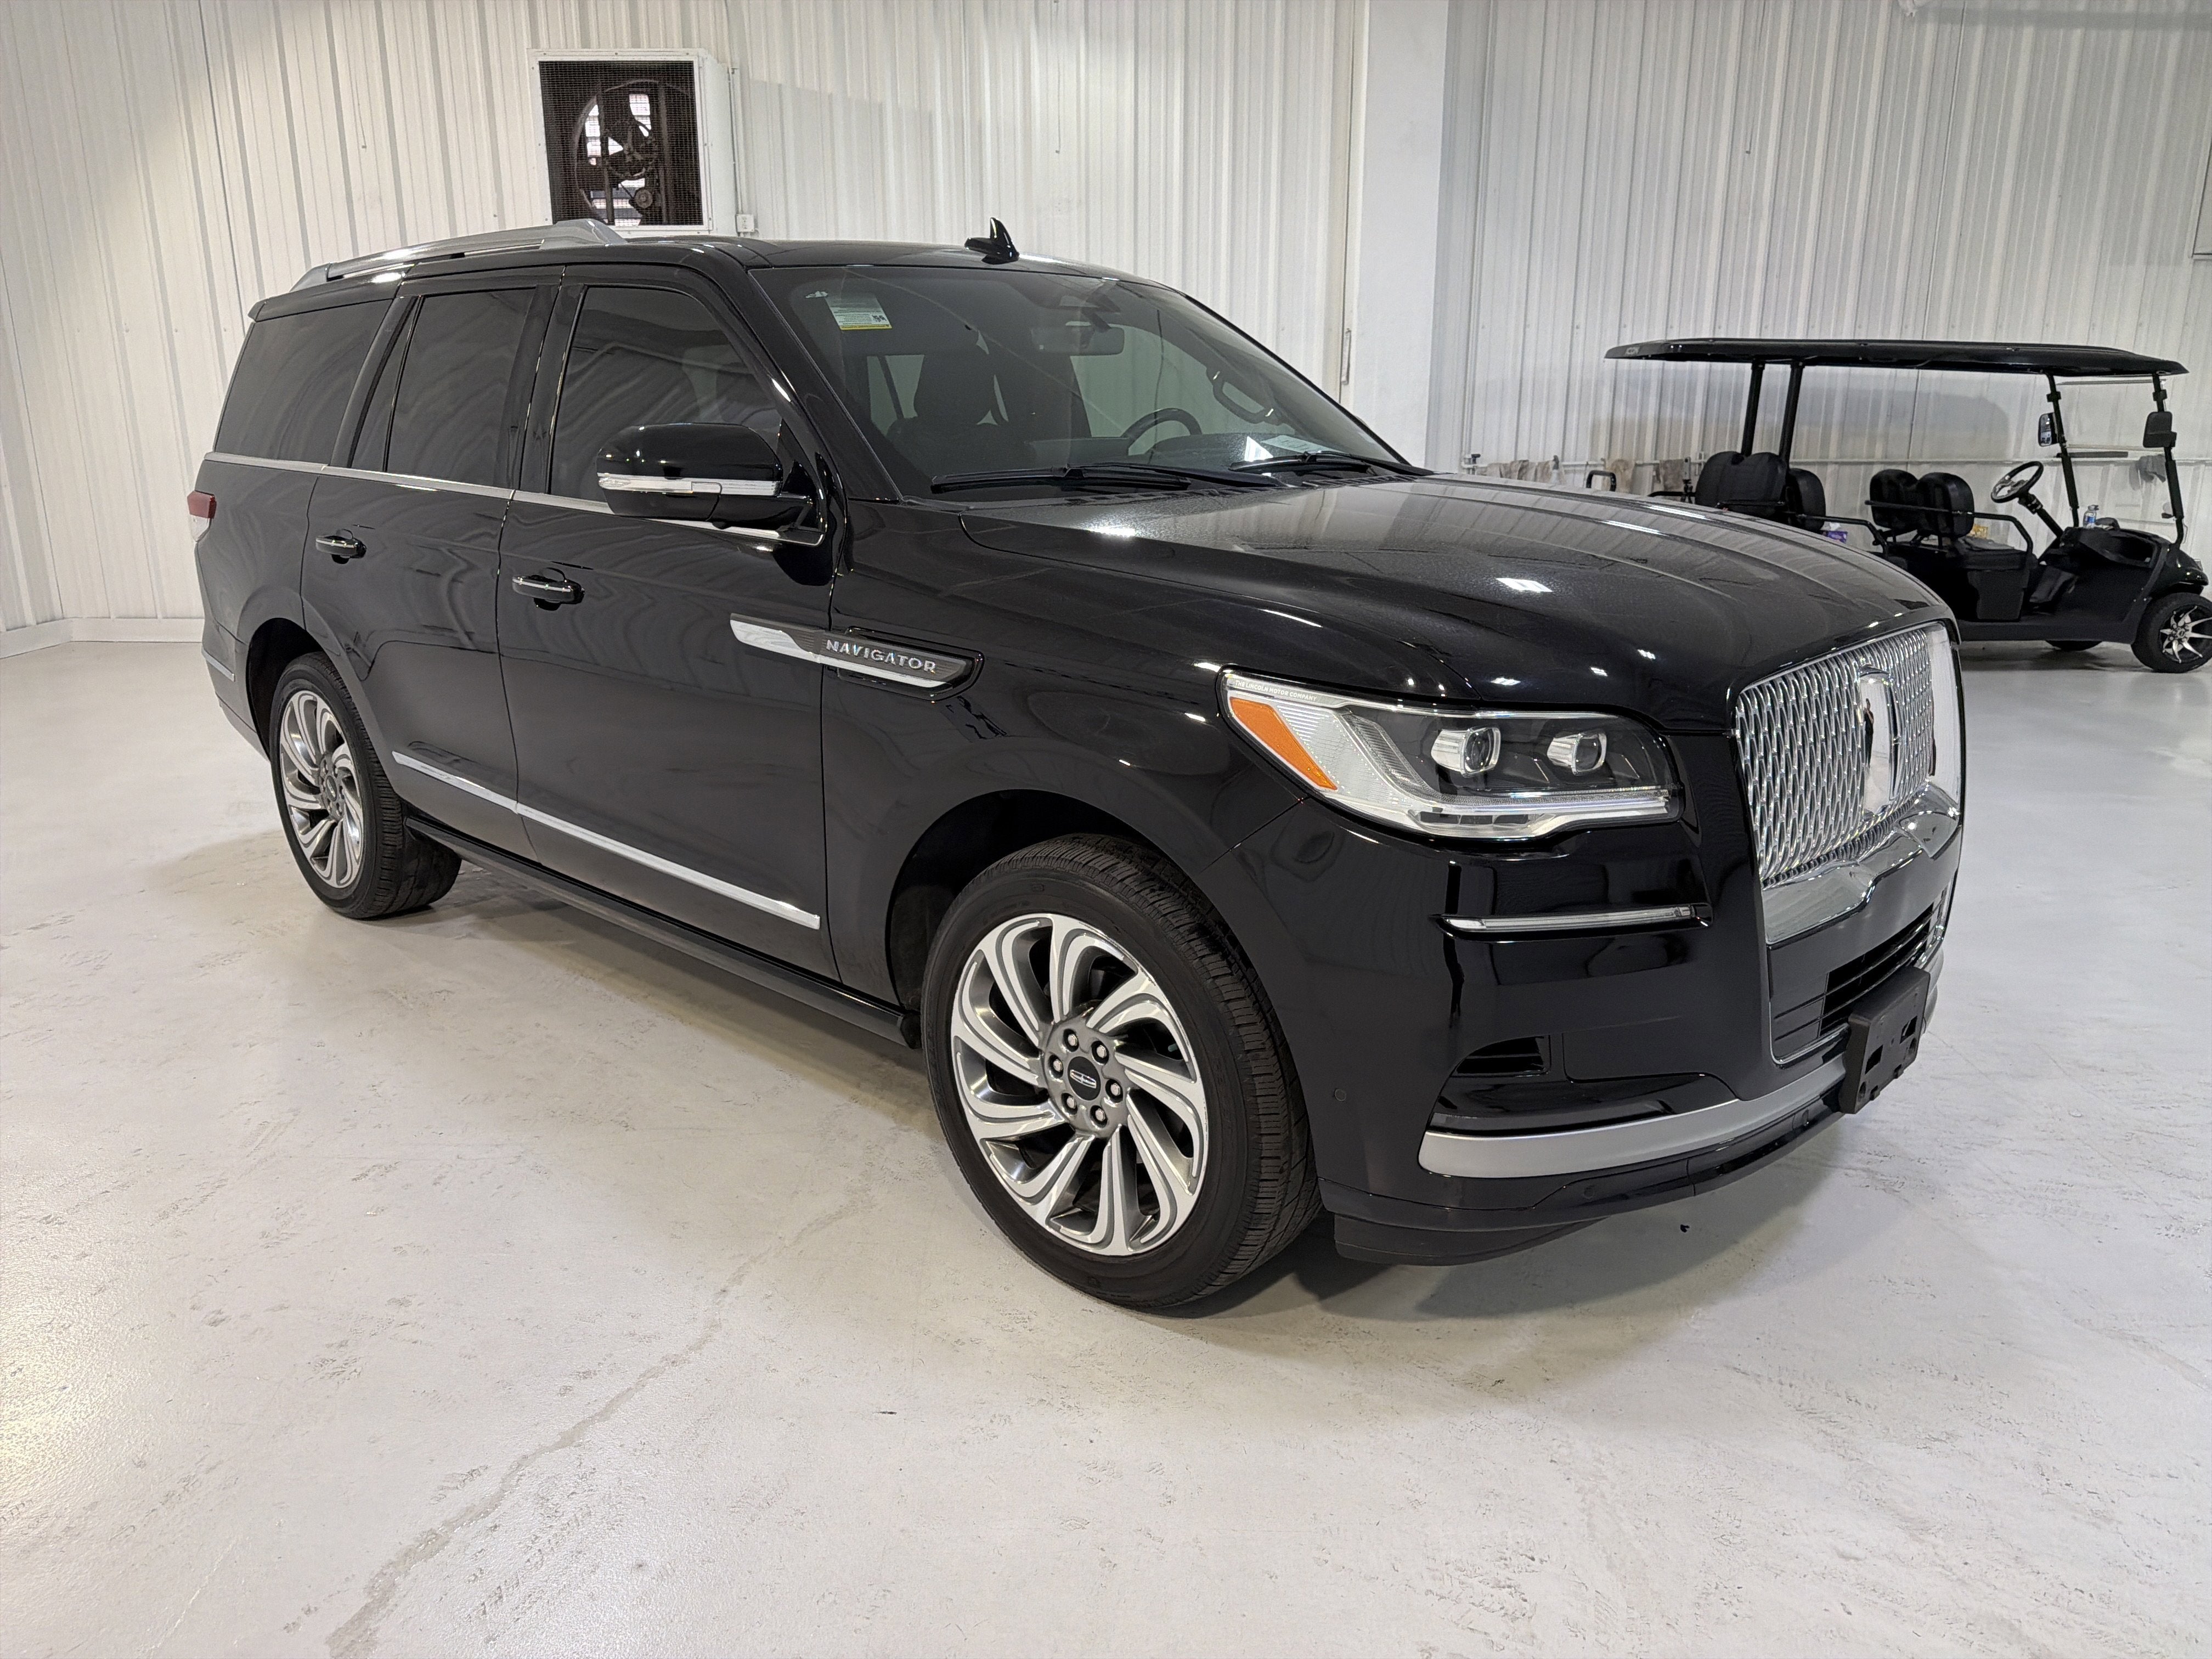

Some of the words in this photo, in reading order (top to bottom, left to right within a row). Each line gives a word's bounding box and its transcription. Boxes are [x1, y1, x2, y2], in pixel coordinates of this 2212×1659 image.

[826, 639, 936, 673] NAVIGATOR
[1245, 682, 1268, 692] LINCOLN
[1269, 688, 1289, 696] MOTOR
[1289, 692, 1317, 701] COMPANY
